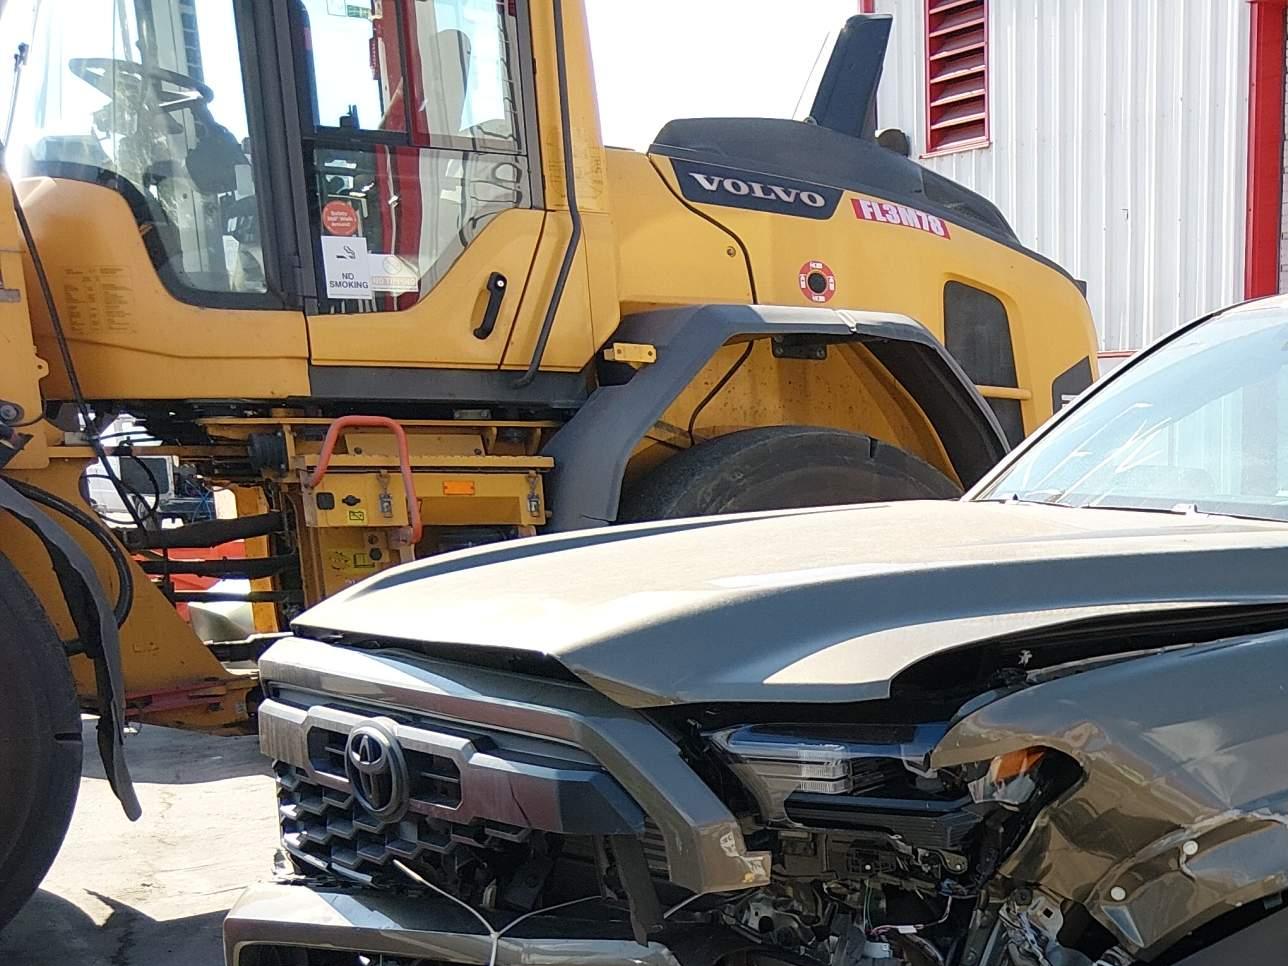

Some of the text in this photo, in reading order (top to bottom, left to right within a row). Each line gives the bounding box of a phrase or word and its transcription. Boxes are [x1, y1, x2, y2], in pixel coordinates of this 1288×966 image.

[689, 172, 826, 208] VOLVO
[859, 199, 945, 237] FL3M78
[329, 280, 369, 289] SMOKING
[341, 272, 355, 280] NO
